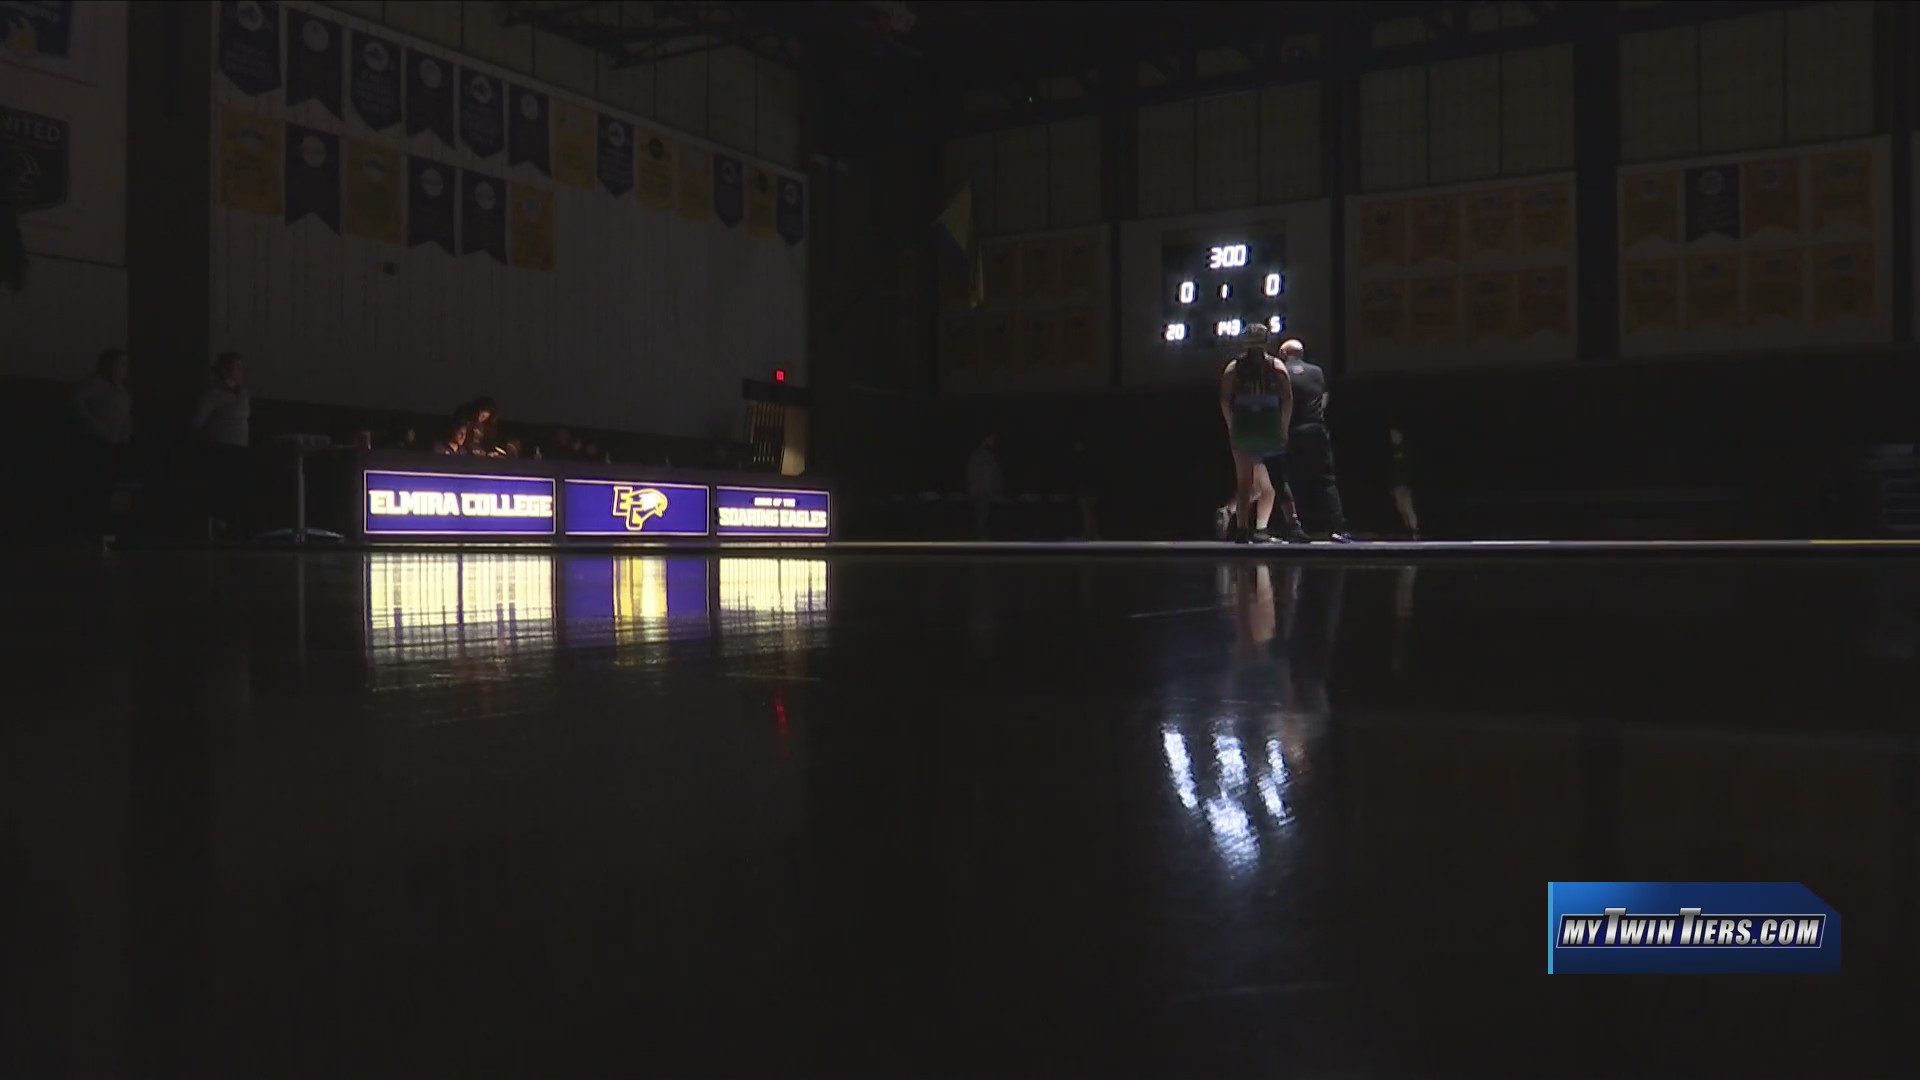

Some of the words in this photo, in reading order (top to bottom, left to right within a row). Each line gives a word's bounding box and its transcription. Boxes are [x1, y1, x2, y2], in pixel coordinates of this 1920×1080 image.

[1180, 281, 1195, 304] 0
[1266, 273, 1280, 296] 0
[1165, 323, 1186, 341] 20
[368, 490, 460, 516] ELMIRA
[461, 493, 553, 517] COLLEGE
[718, 507, 779, 527] SOARING
[779, 509, 827, 528] EAGLES
